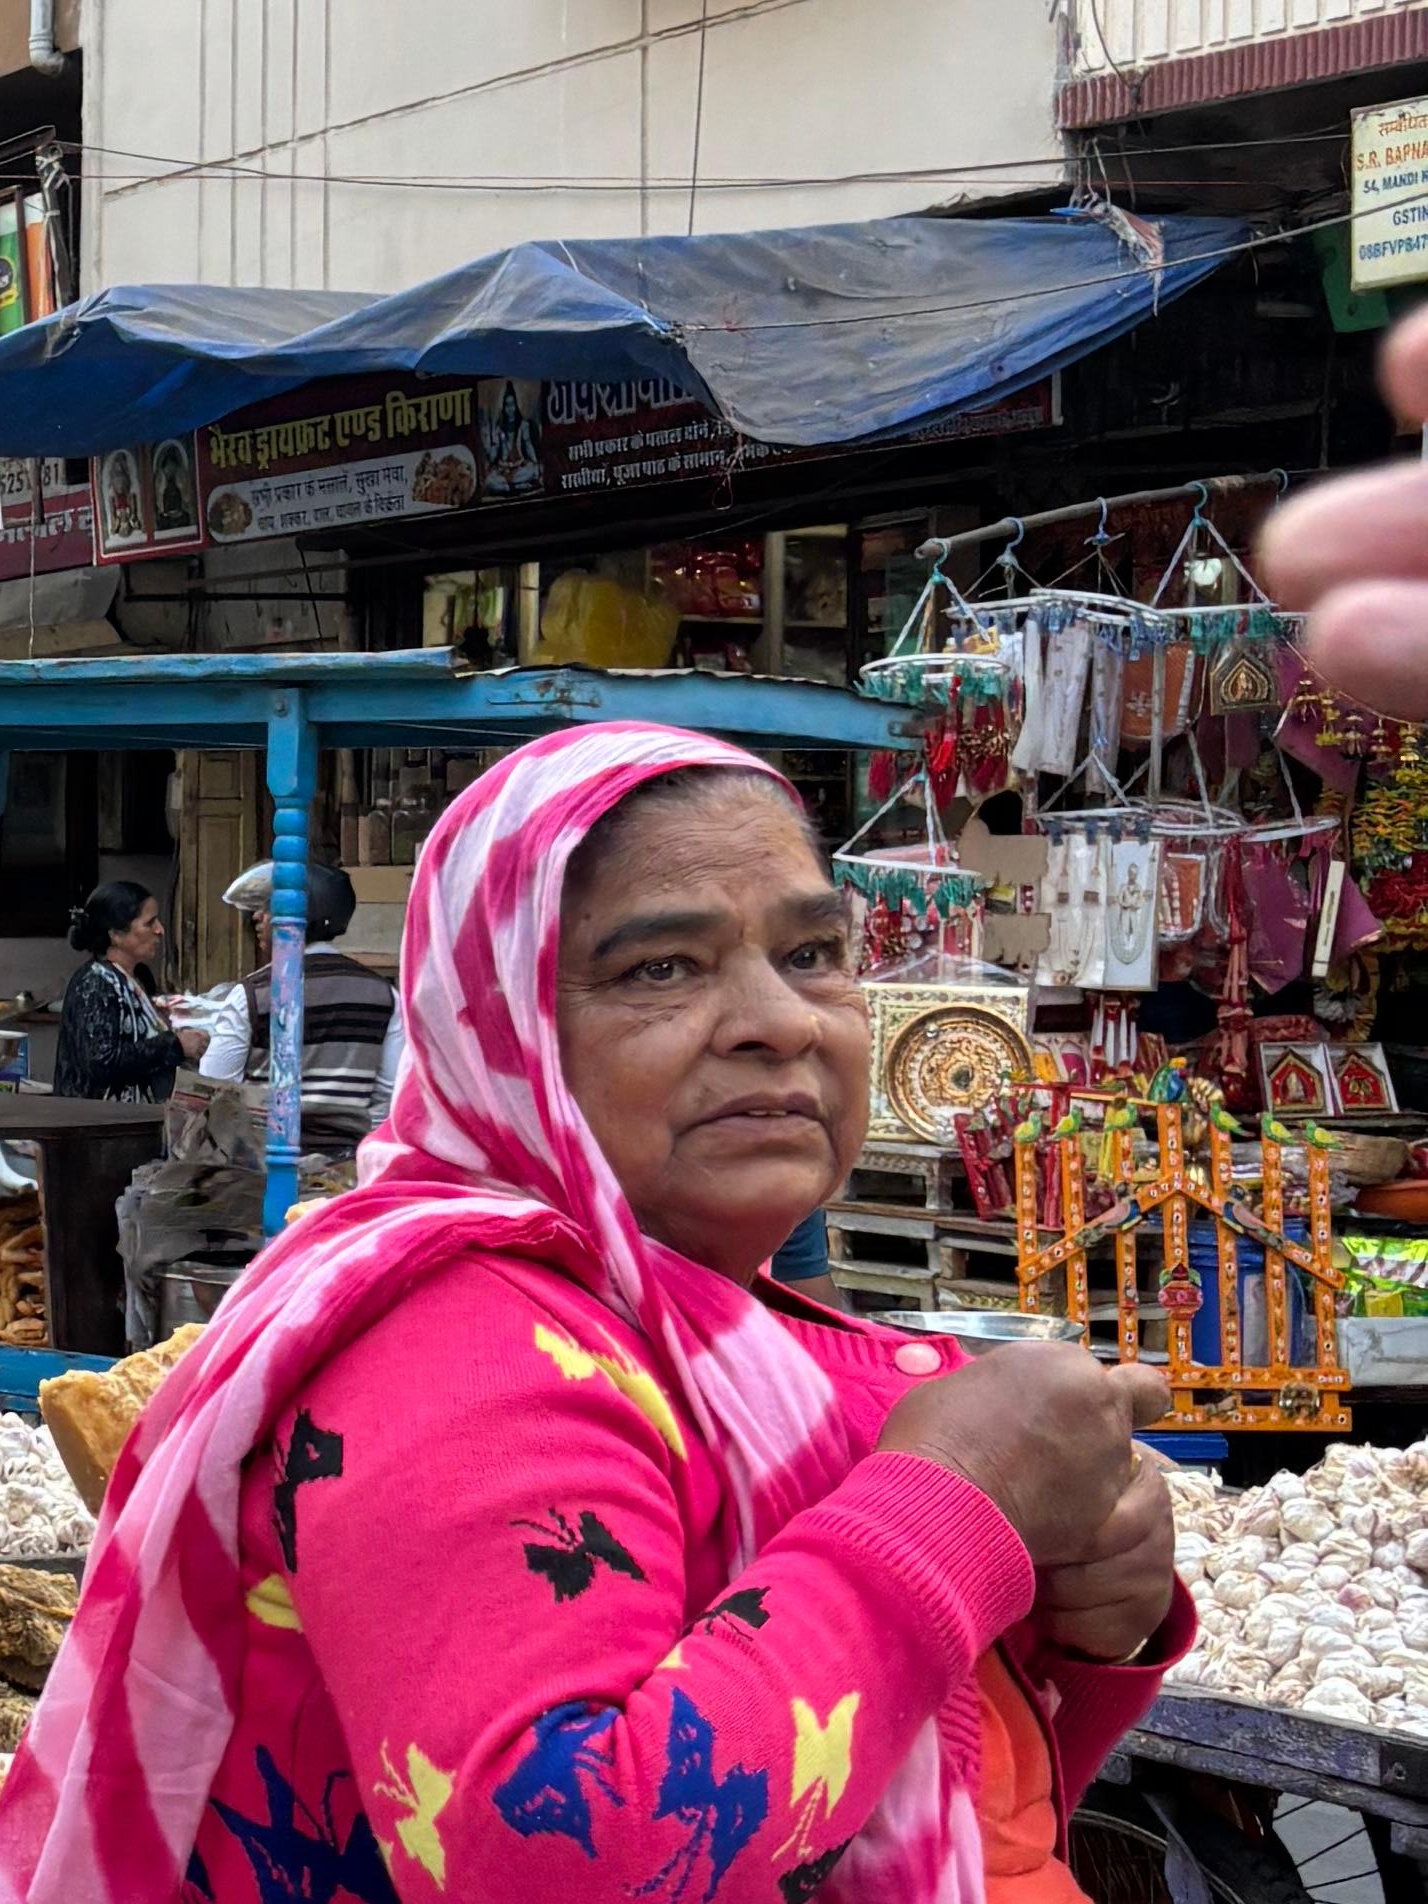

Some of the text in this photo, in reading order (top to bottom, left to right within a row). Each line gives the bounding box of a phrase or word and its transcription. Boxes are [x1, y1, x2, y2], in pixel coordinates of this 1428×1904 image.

[1383, 172, 1418, 190] MANDI
[334, 405, 382, 447] एण्ड
[386, 388, 472, 439] किराणा
